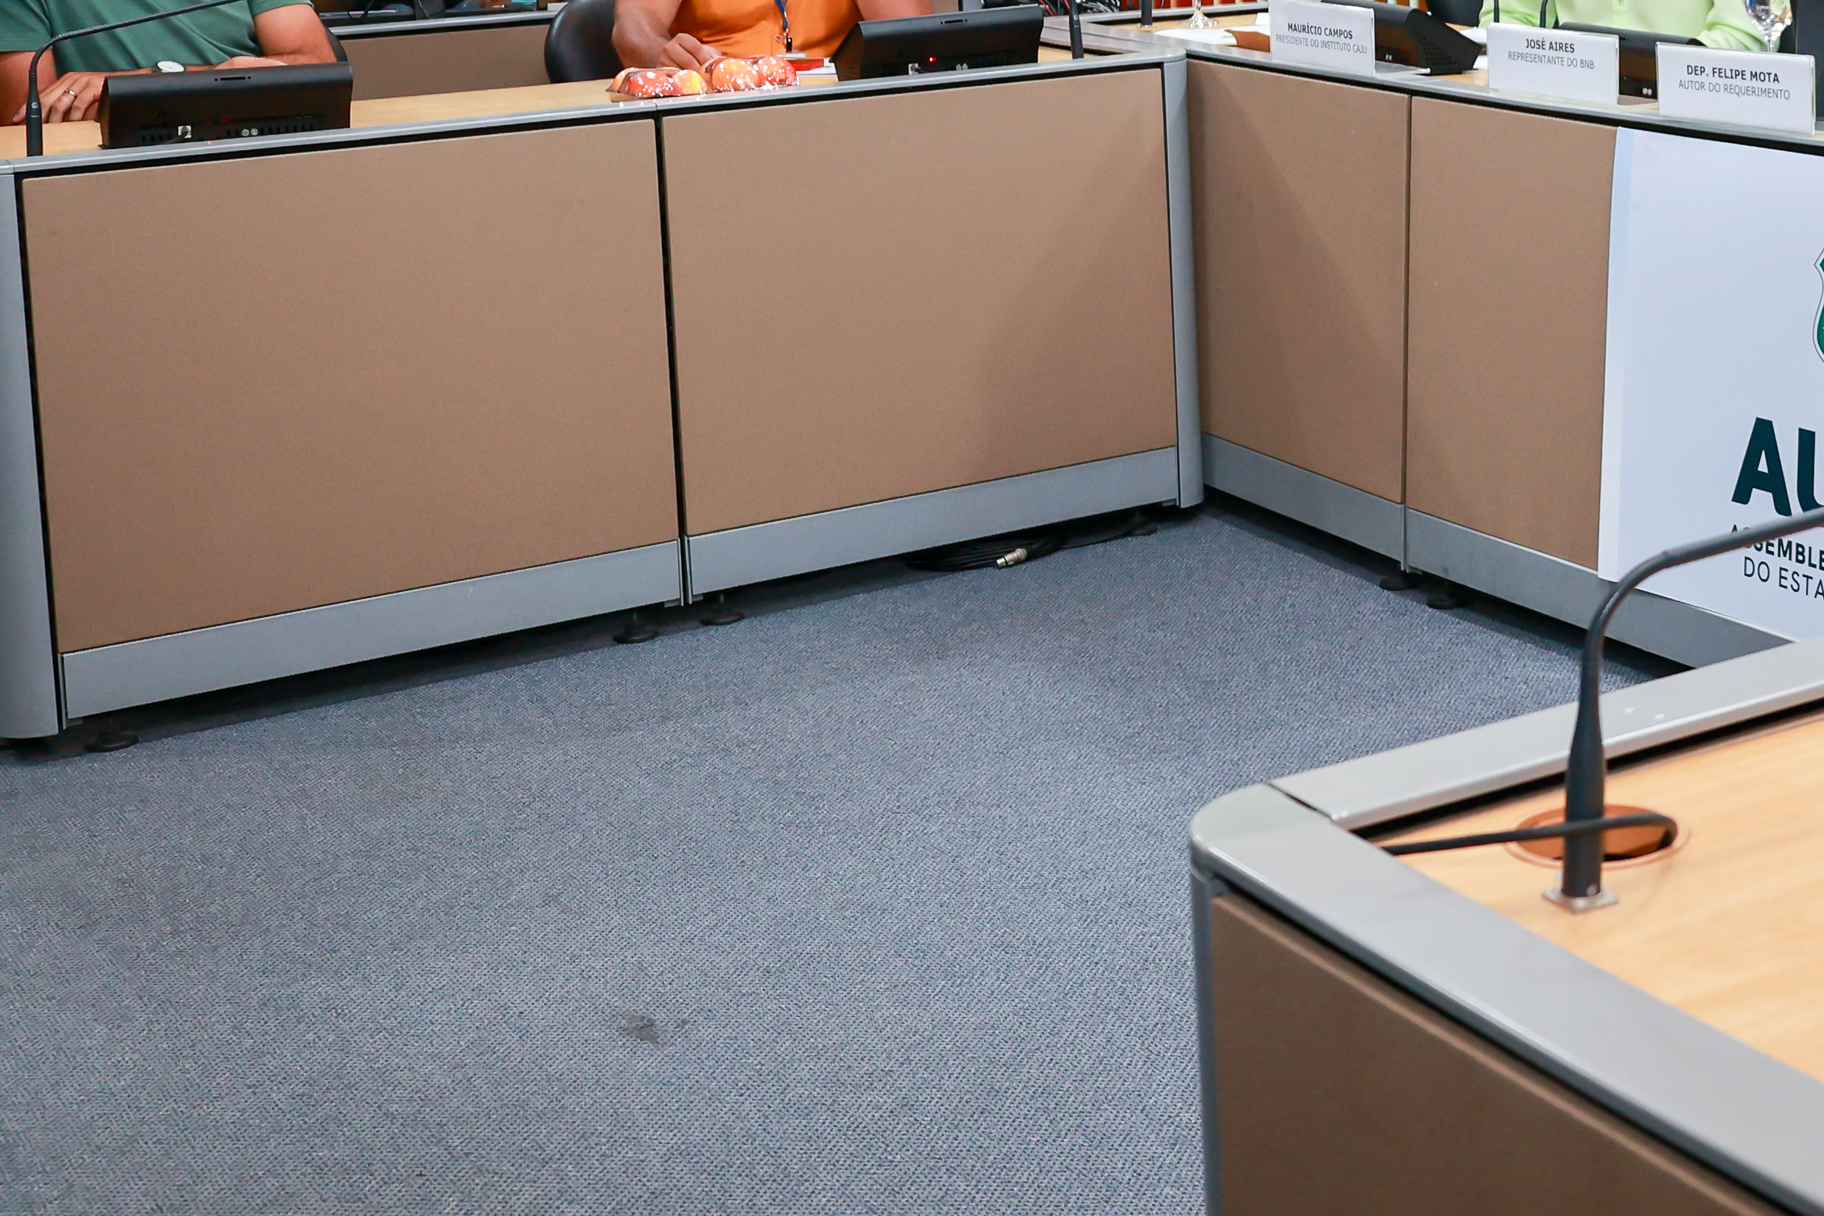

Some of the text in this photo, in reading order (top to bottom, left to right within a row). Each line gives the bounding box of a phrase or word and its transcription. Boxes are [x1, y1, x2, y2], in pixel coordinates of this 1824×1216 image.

[1287, 22, 1353, 40] MAURÍCIO CAMPOS
[1275, 34, 1368, 54] PRESIDENTE DO INSTITUTO CAJU
[1525, 37, 1575, 54] JOSÉ AIRES
[1508, 50, 1595, 70] REPRESENTANTE DO BNB
[1686, 64, 1780, 84] DEP. FELIPE MOTA
[1678, 79, 1791, 100] AUTOR DO REQUERIMENTO
[1743, 556, 1771, 583] DO
